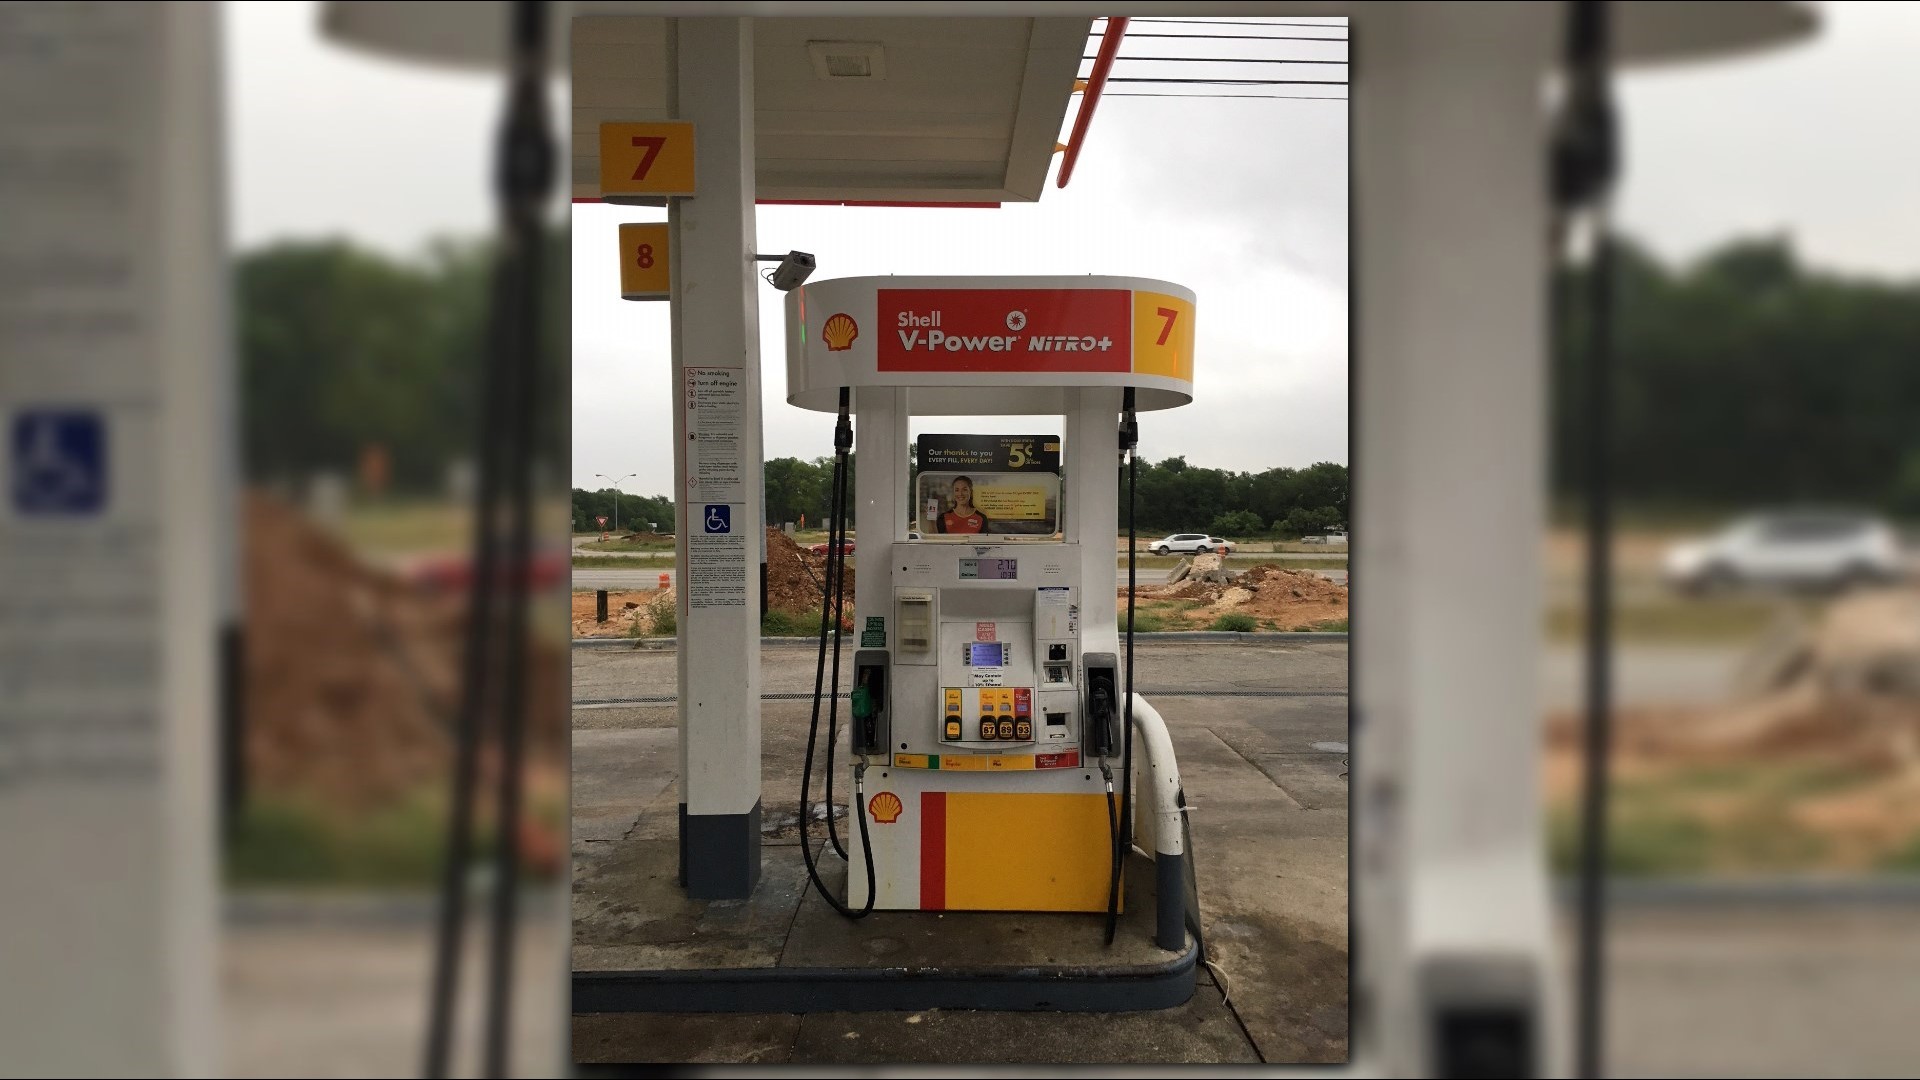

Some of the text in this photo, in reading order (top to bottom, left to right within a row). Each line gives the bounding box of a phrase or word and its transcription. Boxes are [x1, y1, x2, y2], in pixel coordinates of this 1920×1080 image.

[632, 136, 668, 181] 7
[637, 243, 654, 269] 8
[897, 310, 941, 327] Shell
[1155, 306, 1179, 346] 7
[897, 329, 1017, 352] V-Power
[707, 370, 730, 378] smoking
[928, 448, 943, 456] Our
[943, 448, 969, 456] thanks
[979, 450, 993, 458] you
[983, 726, 995, 734] 87
[1001, 726, 1012, 734] 89
[1018, 726, 1030, 734] 93
